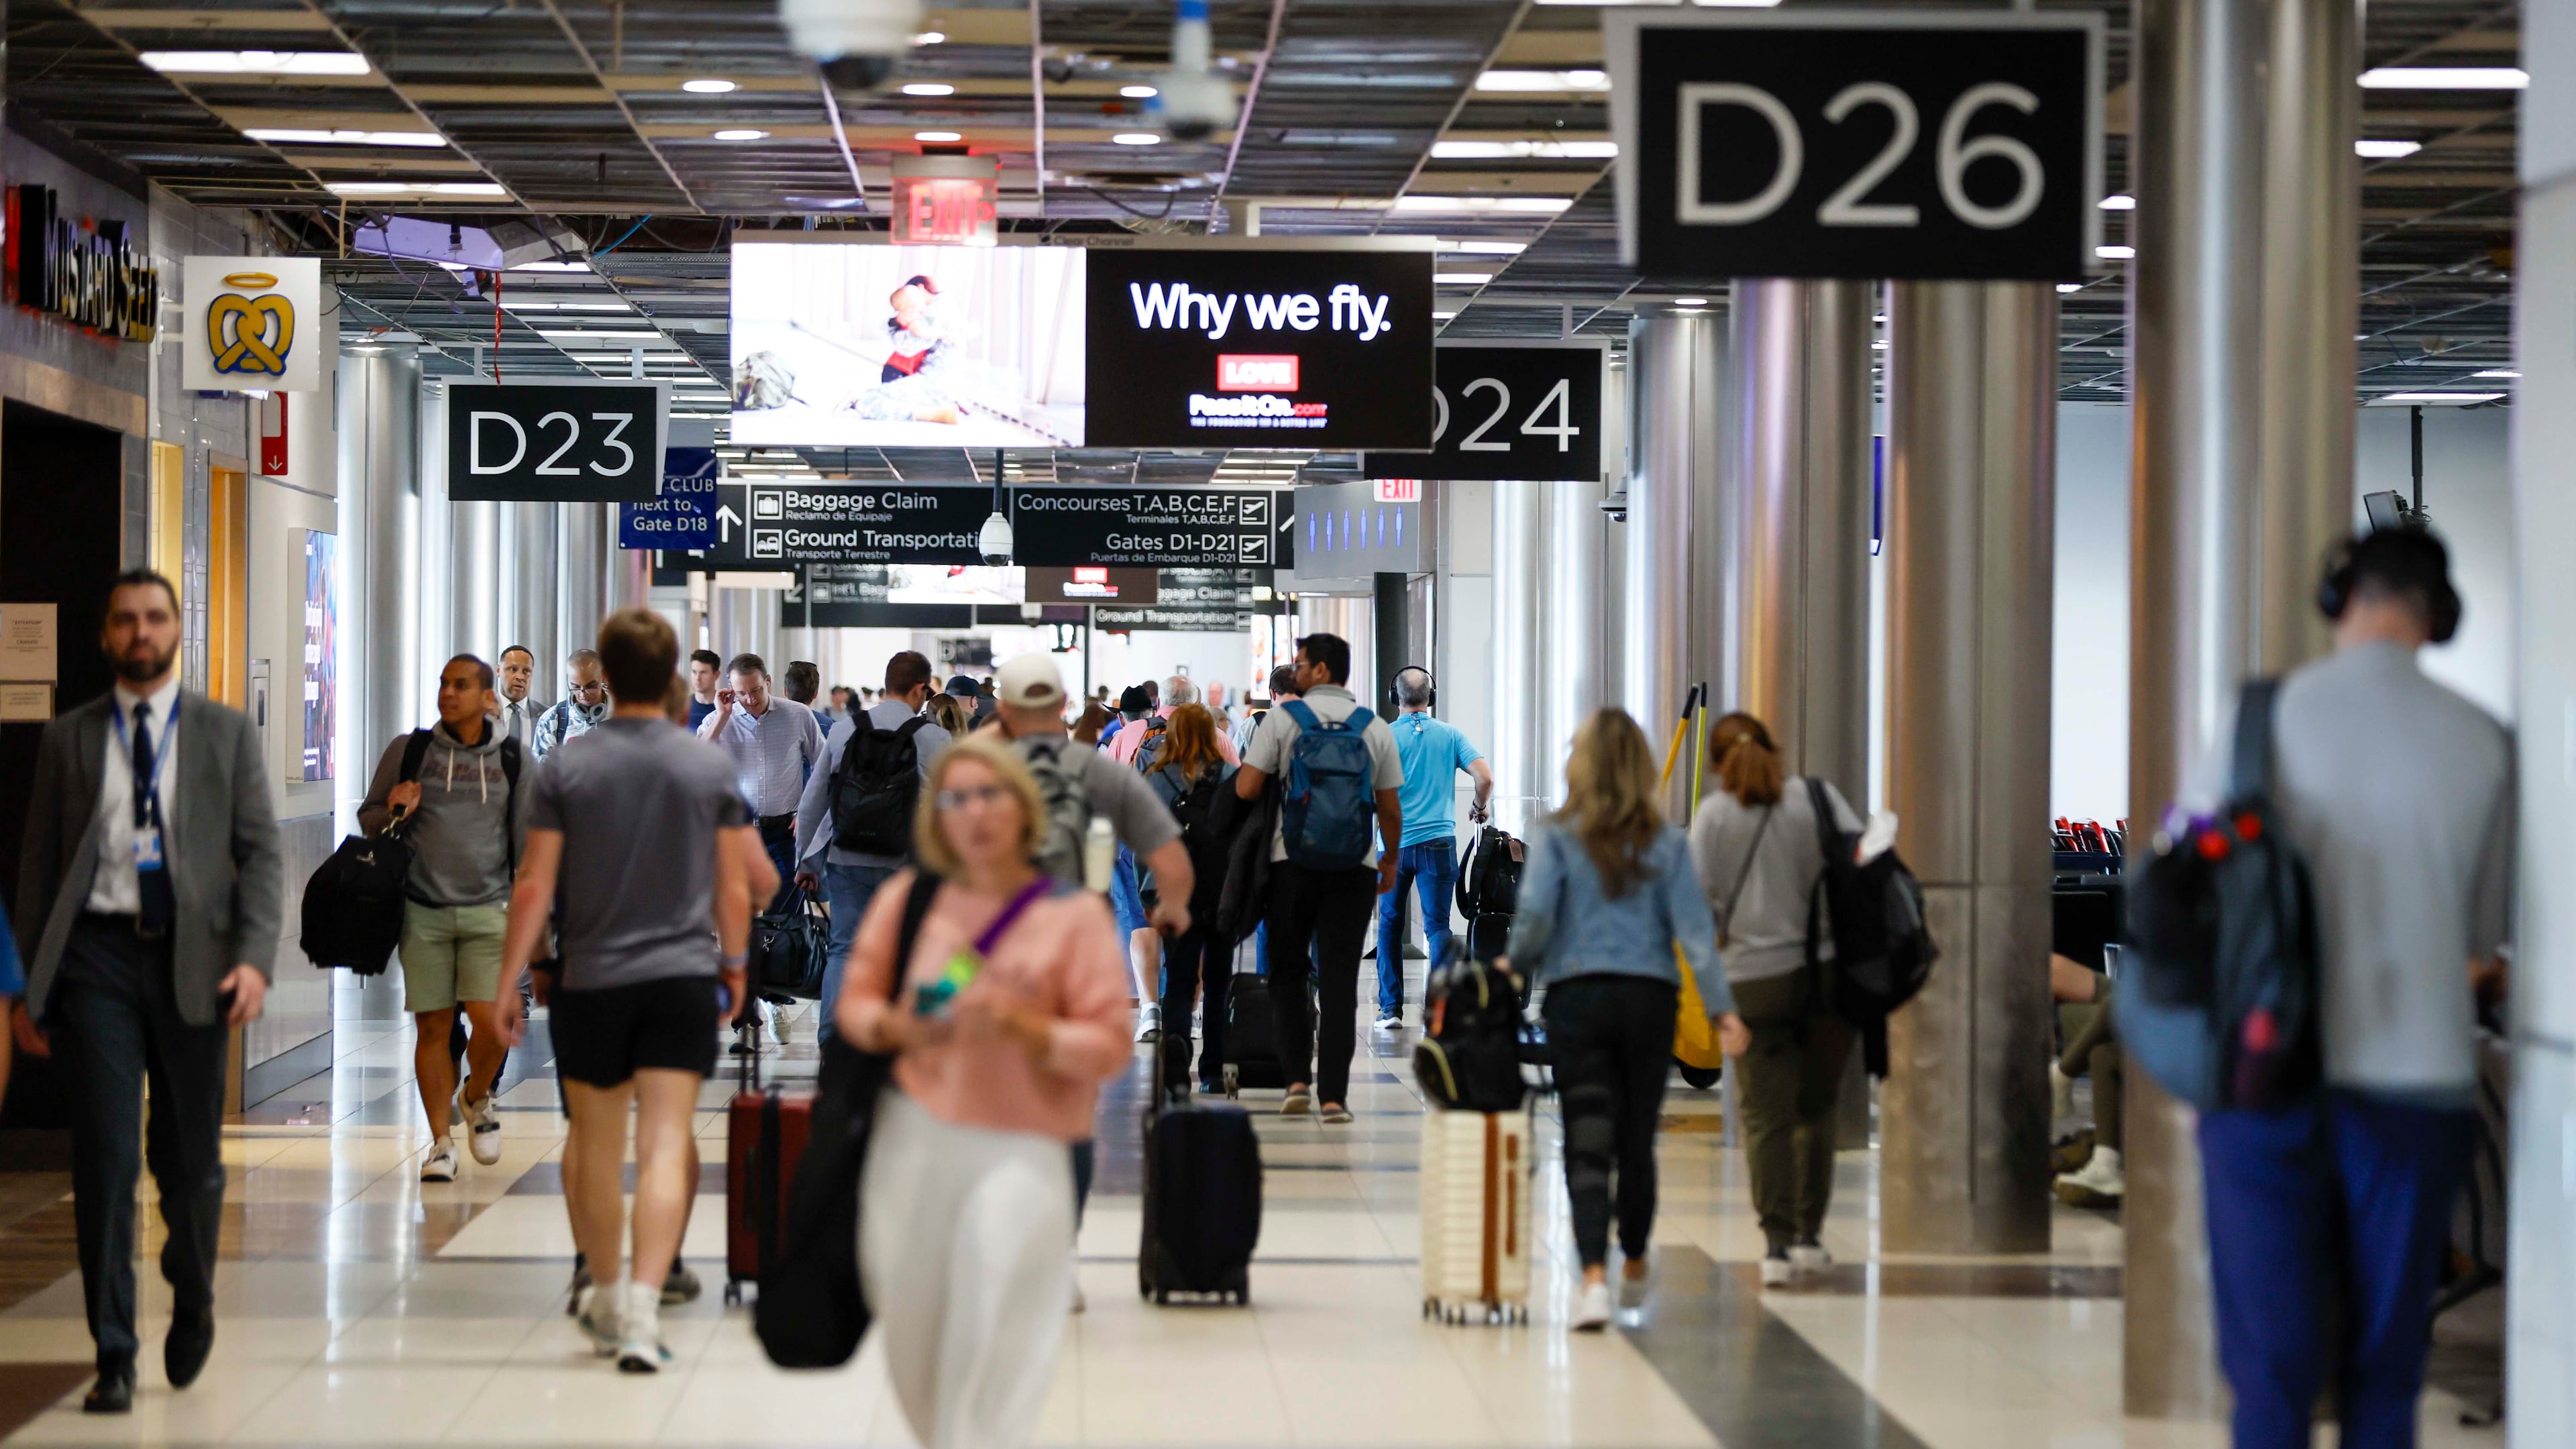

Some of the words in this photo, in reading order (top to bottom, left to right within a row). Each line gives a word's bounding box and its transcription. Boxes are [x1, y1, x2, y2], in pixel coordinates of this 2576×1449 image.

[1675, 80, 2045, 230] D26
[910, 183, 984, 241] EXIT
[1087, 235, 1134, 246] Channel
[1130, 282, 1238, 339] Why
[1244, 293, 1320, 331] we
[1328, 284, 1392, 341] fly.
[1225, 362, 1291, 384] LOVE
[470, 411, 634, 477] D23
[671, 478, 714, 492] CLUB
[1383, 479, 1413, 499] EXIT
[633, 498, 669, 511] next
[674, 498, 691, 511] to
[786, 490, 875, 512] Baggage
[881, 492, 938, 509] Claim
[1018, 494, 1131, 511] Concourses
[1133, 494, 1236, 513] T,A,B,C,E,F
[633, 517, 672, 531] Gate
[677, 517, 708, 531] D18
[786, 511, 830, 521] Reclamo
[832, 511, 846, 521] de
[848, 511, 893, 523] Equipaje
[1126, 514, 1179, 524] Terminales
[1182, 515, 1236, 525] T,A,B,C,E,F
[784, 529, 857, 547] Ground
[863, 529, 978, 551] Transportati
[1107, 533, 1163, 550] Gates
[1170, 534, 1235, 550] D1-D21
[786, 549, 841, 559] Transporte
[844, 549, 891, 559] Terrestre
[1090, 552, 1130, 562] Puertas
[1131, 553, 1145, 562] de
[1148, 553, 1200, 564] Embarque
[1197, 586, 1236, 600] Claim
[1096, 609, 1143, 623] Ground
[1144, 609, 1236, 625] Transportation
